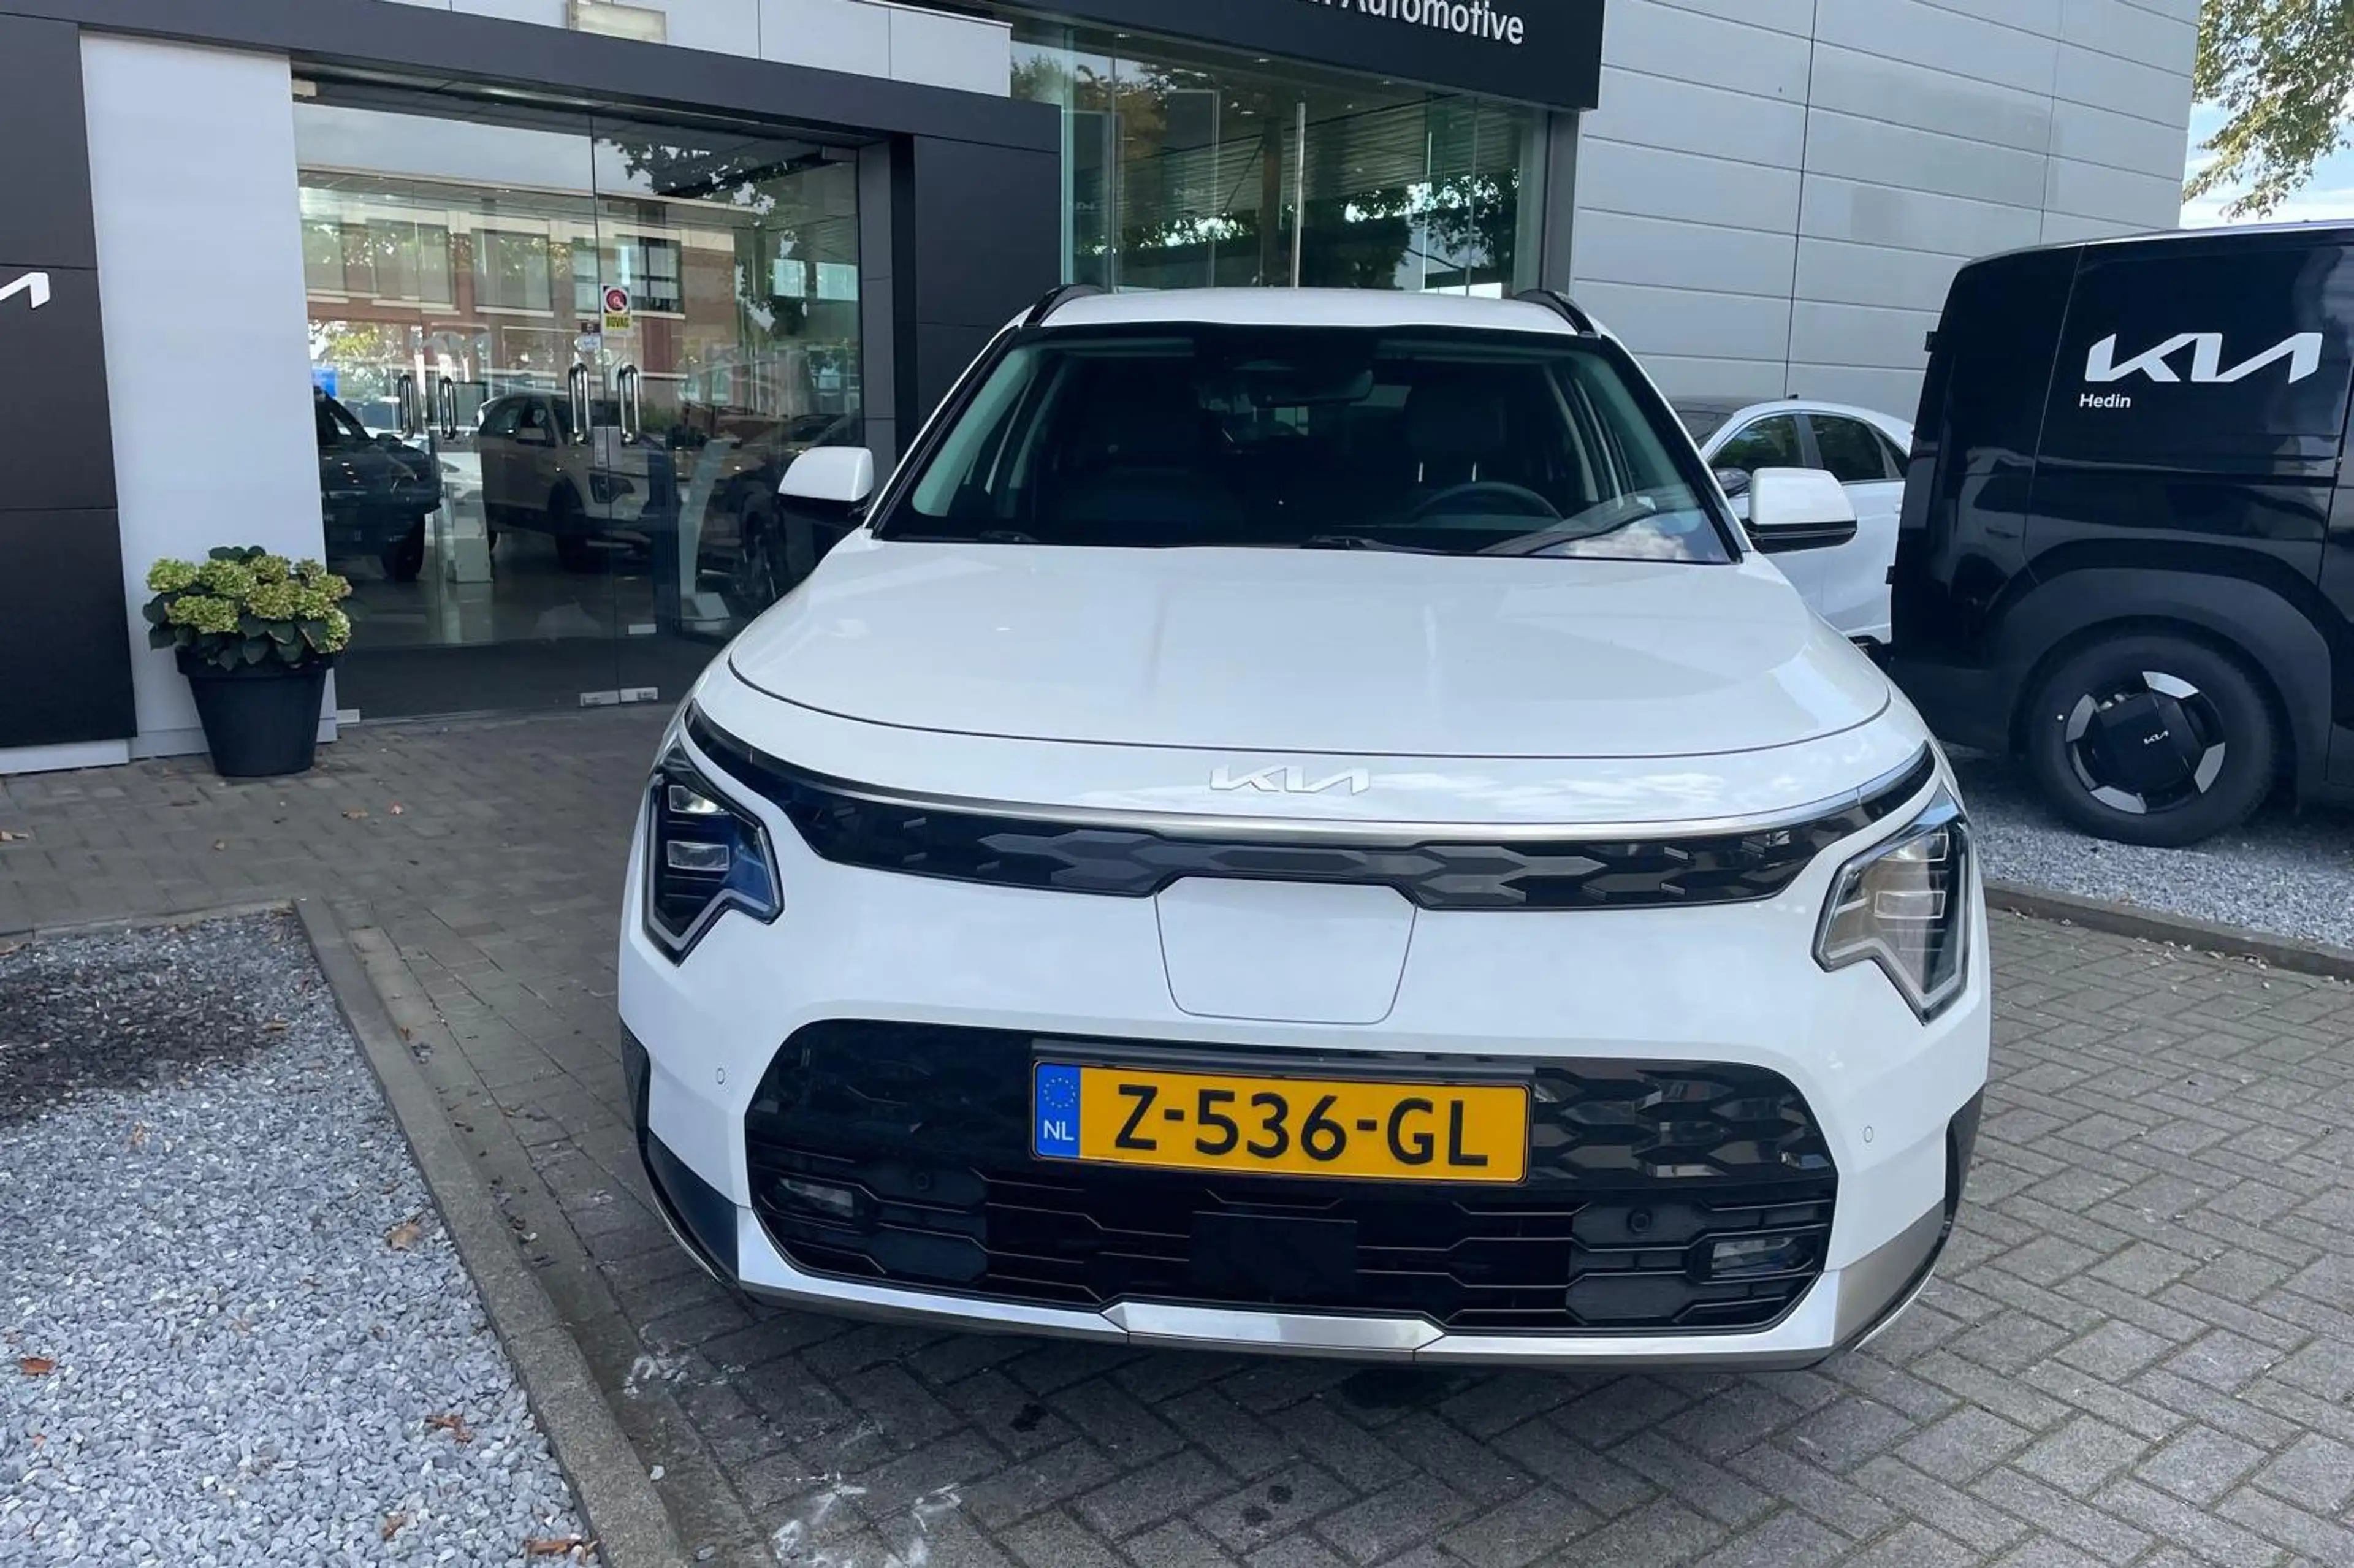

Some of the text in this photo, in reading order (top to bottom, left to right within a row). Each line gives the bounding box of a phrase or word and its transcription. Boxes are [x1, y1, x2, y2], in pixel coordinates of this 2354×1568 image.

[2085, 332, 2323, 383] KIA
[2079, 394, 2131, 409] Hedin
[1209, 764, 1370, 795] KIA
[1043, 1120, 1074, 1141] NL
[1114, 1083, 1488, 1168] Z-536-GL
